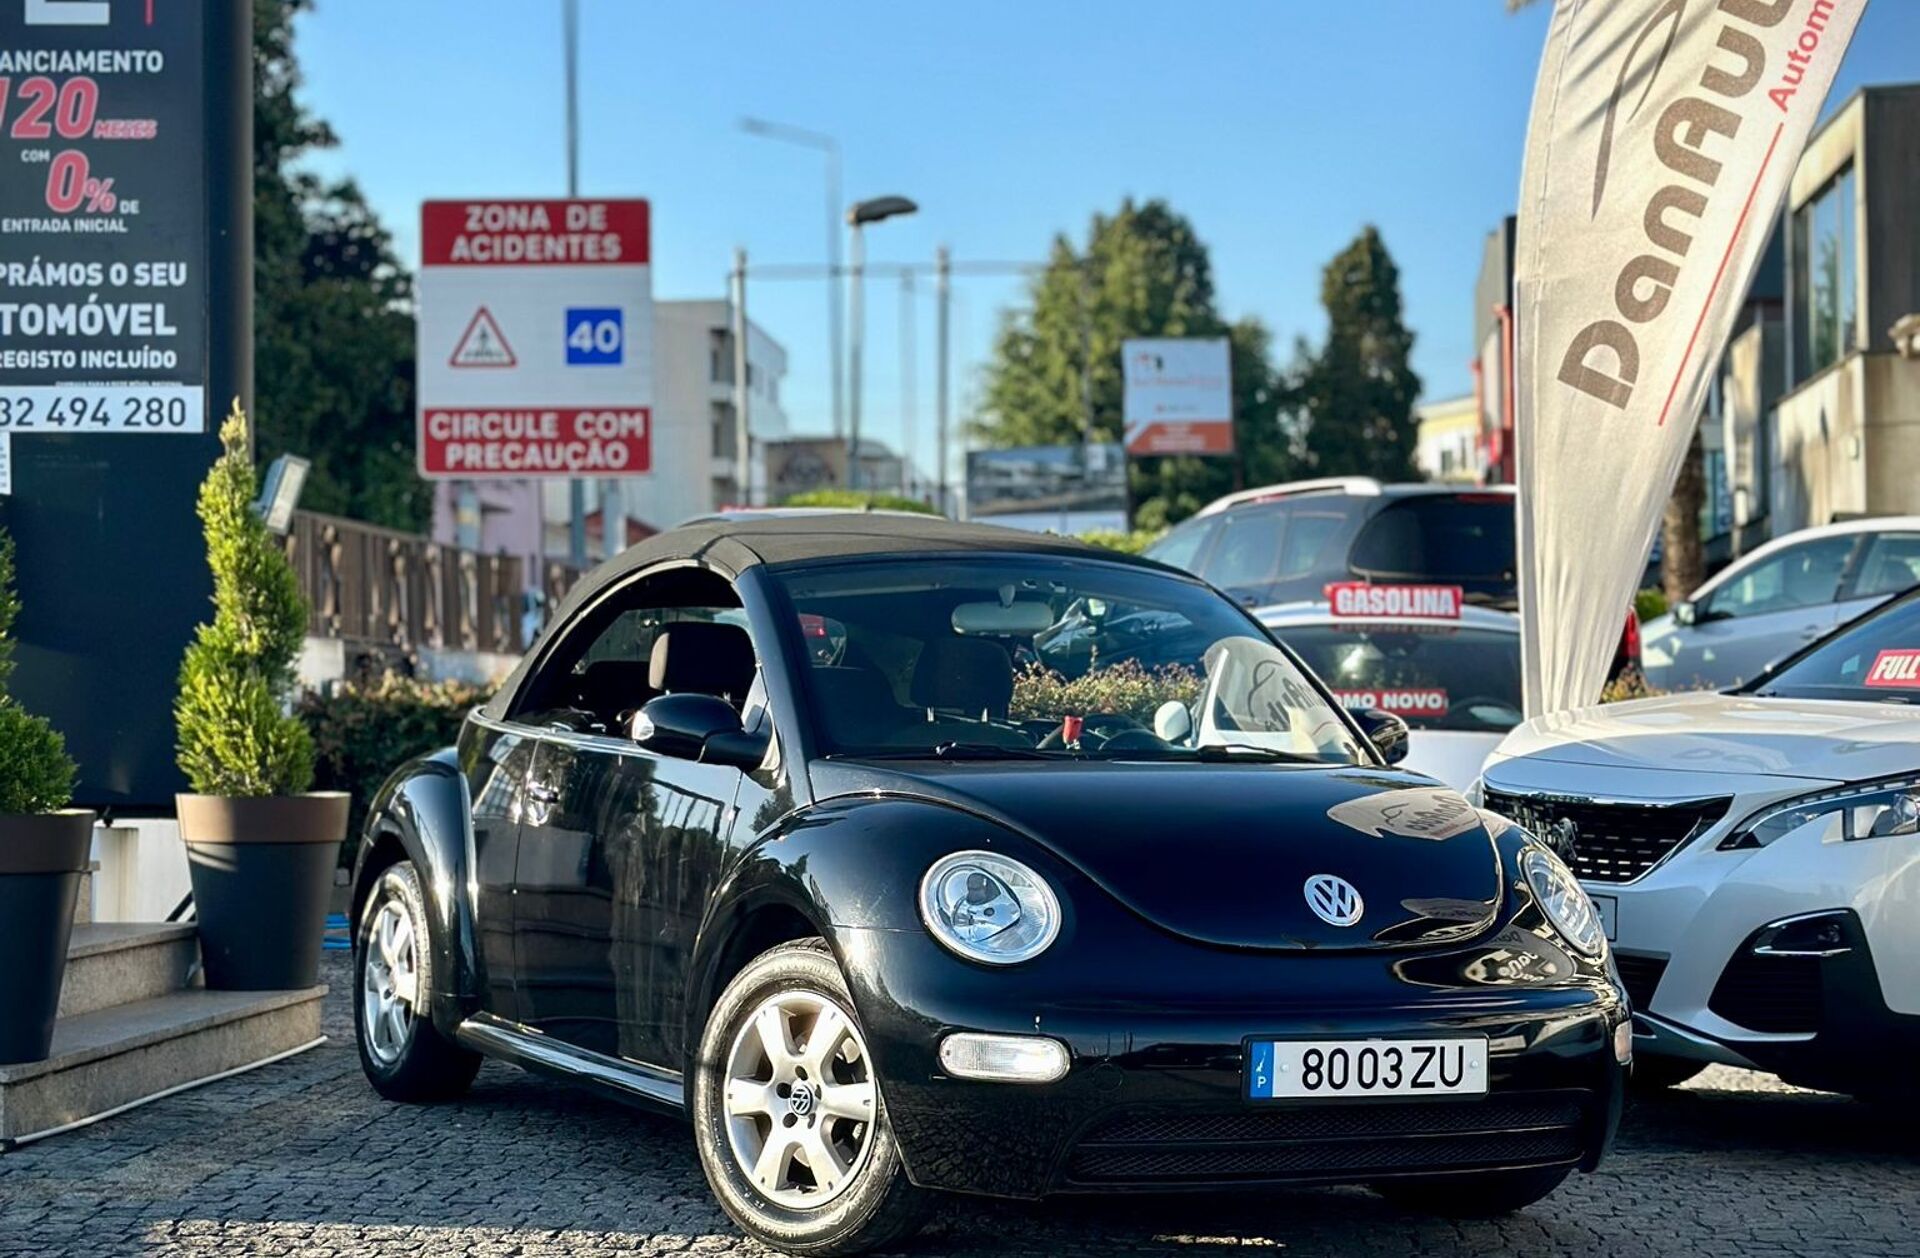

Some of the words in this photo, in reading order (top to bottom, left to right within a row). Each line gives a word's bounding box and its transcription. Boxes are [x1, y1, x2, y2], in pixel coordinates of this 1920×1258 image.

[0, 50, 164, 73] ANCIAMENTO
[21, 150, 50, 163] COM
[45, 149, 117, 214] 0%
[119, 200, 140, 214] DE
[2, 218, 71, 233] ENTRADA
[74, 218, 128, 233] INICIAL
[465, 204, 549, 231] ZONA
[566, 204, 607, 231] DE
[451, 233, 622, 262] ACIDENTES
[109, 263, 129, 287] O
[133, 262, 188, 287] SEU
[567, 319, 621, 353] 40
[0, 350, 76, 369] EGISTO
[80, 345, 178, 369] INCLUÍDO
[46, 397, 111, 427] 494
[123, 397, 187, 427] 280
[428, 411, 559, 439] CIRCULE
[574, 411, 645, 438] COM
[444, 437, 630, 474] PRECAUÇÃO
[1335, 587, 1456, 616] GASOLINA
[1871, 655, 1920, 680] FULL
[1382, 692, 1443, 710] NOVO
[1257, 1078, 1267, 1088] P
